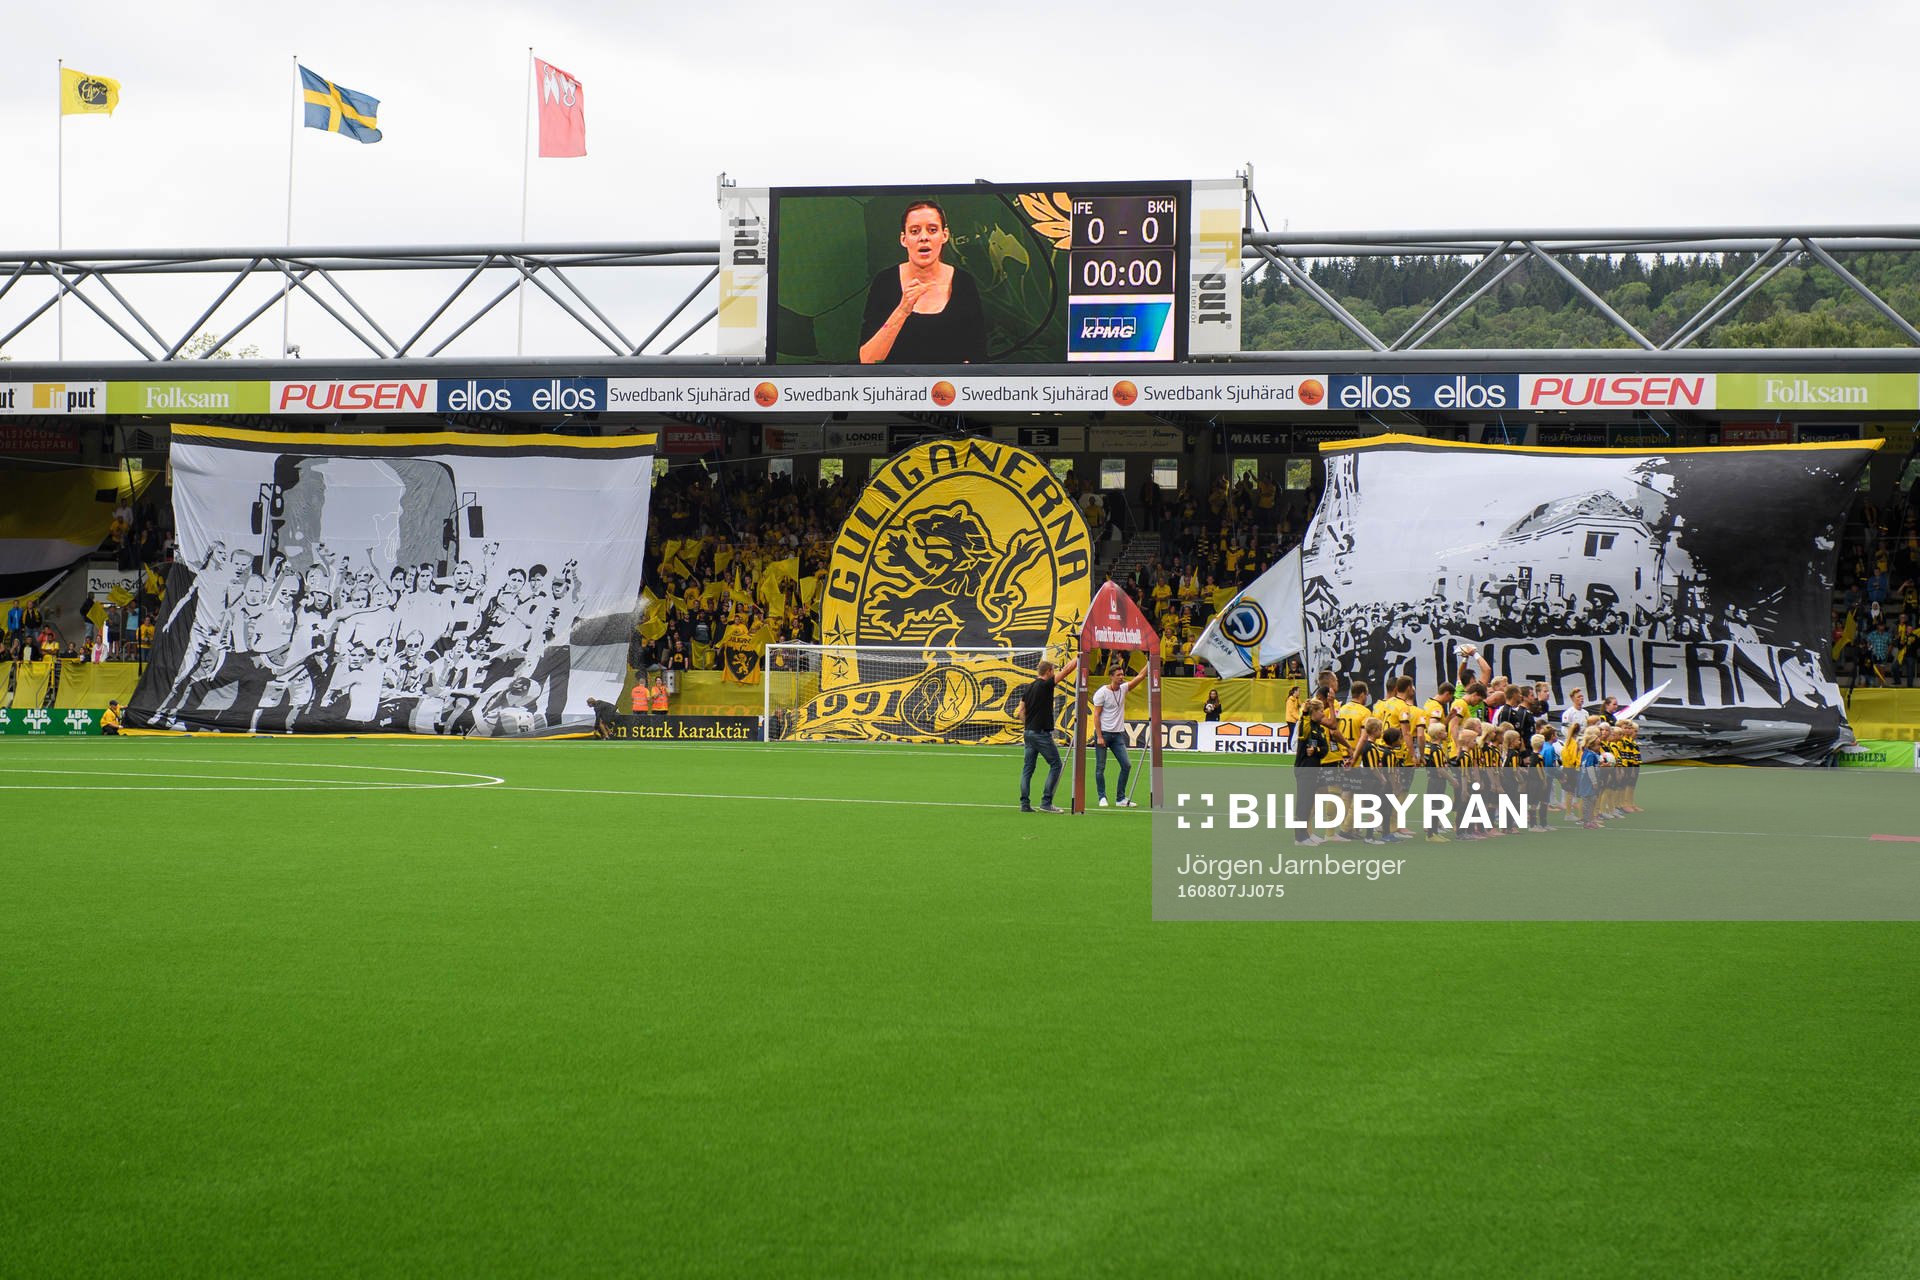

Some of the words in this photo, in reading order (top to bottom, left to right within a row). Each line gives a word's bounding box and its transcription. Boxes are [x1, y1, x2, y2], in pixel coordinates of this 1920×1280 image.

[1074, 202, 1093, 215] IFE
[1148, 200, 1174, 213] BKH
[1088, 218, 1105, 245] 0
[1142, 217, 1159, 243] 0
[1083, 260, 1162, 287] 00:00
[1081, 322, 1136, 338] KPMG
[146, 387, 229, 408] Folksam
[279, 383, 428, 410] PULSEN
[449, 380, 512, 410] ellos
[532, 380, 595, 410] ellos
[610, 387, 683, 402] Swedbank
[688, 386, 750, 405] Sjuhärad
[784, 387, 859, 402] Swedbank
[863, 386, 927, 404] Sjuhärad
[962, 386, 1038, 401] Swedbank
[1043, 385, 1109, 404] Sjuhärad
[1144, 386, 1222, 401] Swedbank
[1226, 385, 1294, 404] Sjuhärad
[1340, 376, 1411, 408] ellos
[1434, 375, 1506, 408] ellos
[1530, 377, 1705, 406] PULSEN
[1766, 379, 1869, 404] Folksam
[1231, 434, 1270, 443] MAKE
[828, 442, 1089, 604] GULIGANERNA
[27, 709, 48, 719] LBC
[68, 709, 88, 719] LBC
[803, 689, 902, 722] 1991
[632, 721, 674, 738] stark
[678, 721, 750, 739] karaktär
